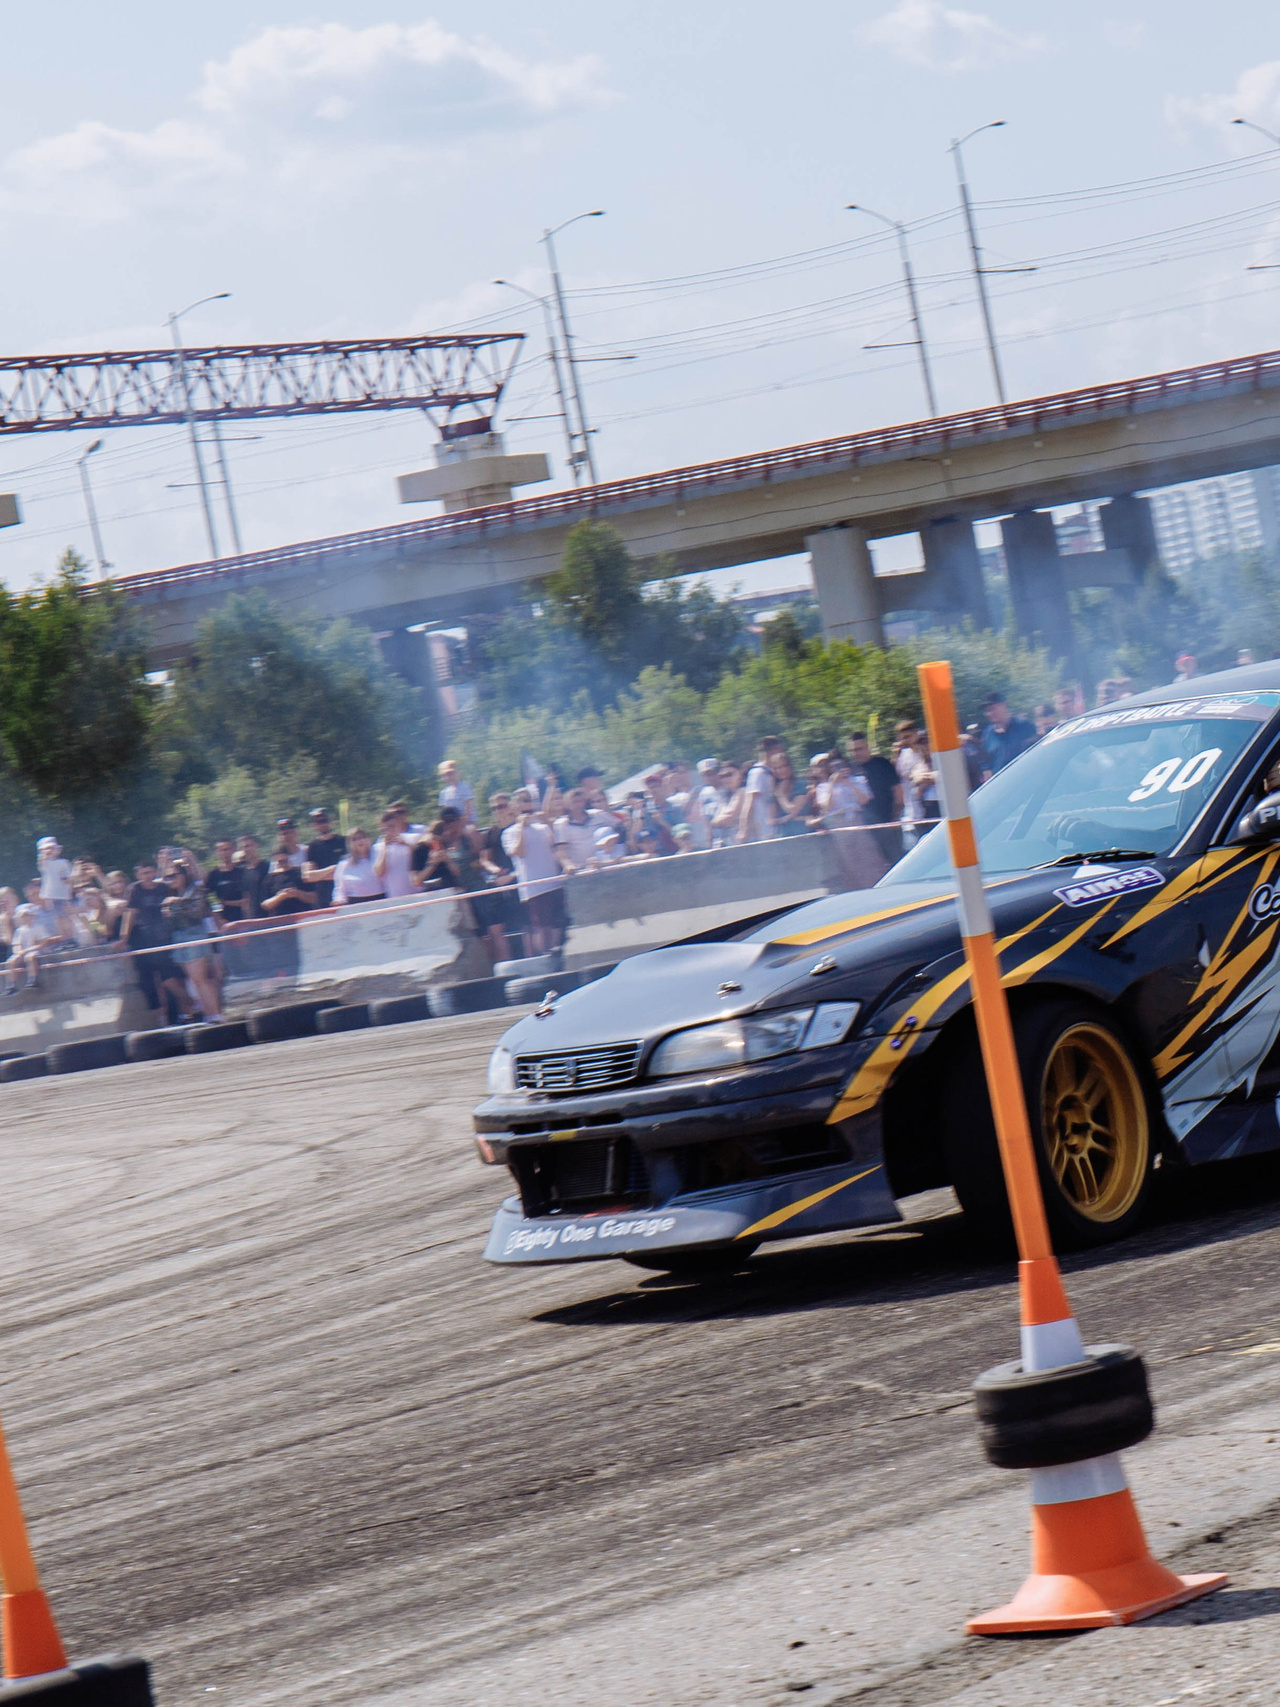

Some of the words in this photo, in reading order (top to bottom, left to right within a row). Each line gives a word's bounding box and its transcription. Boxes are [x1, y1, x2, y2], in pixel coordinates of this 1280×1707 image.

[1127, 748, 1223, 802] 90
[559, 1224, 597, 1243] One
[598, 1217, 677, 1238] Garage
